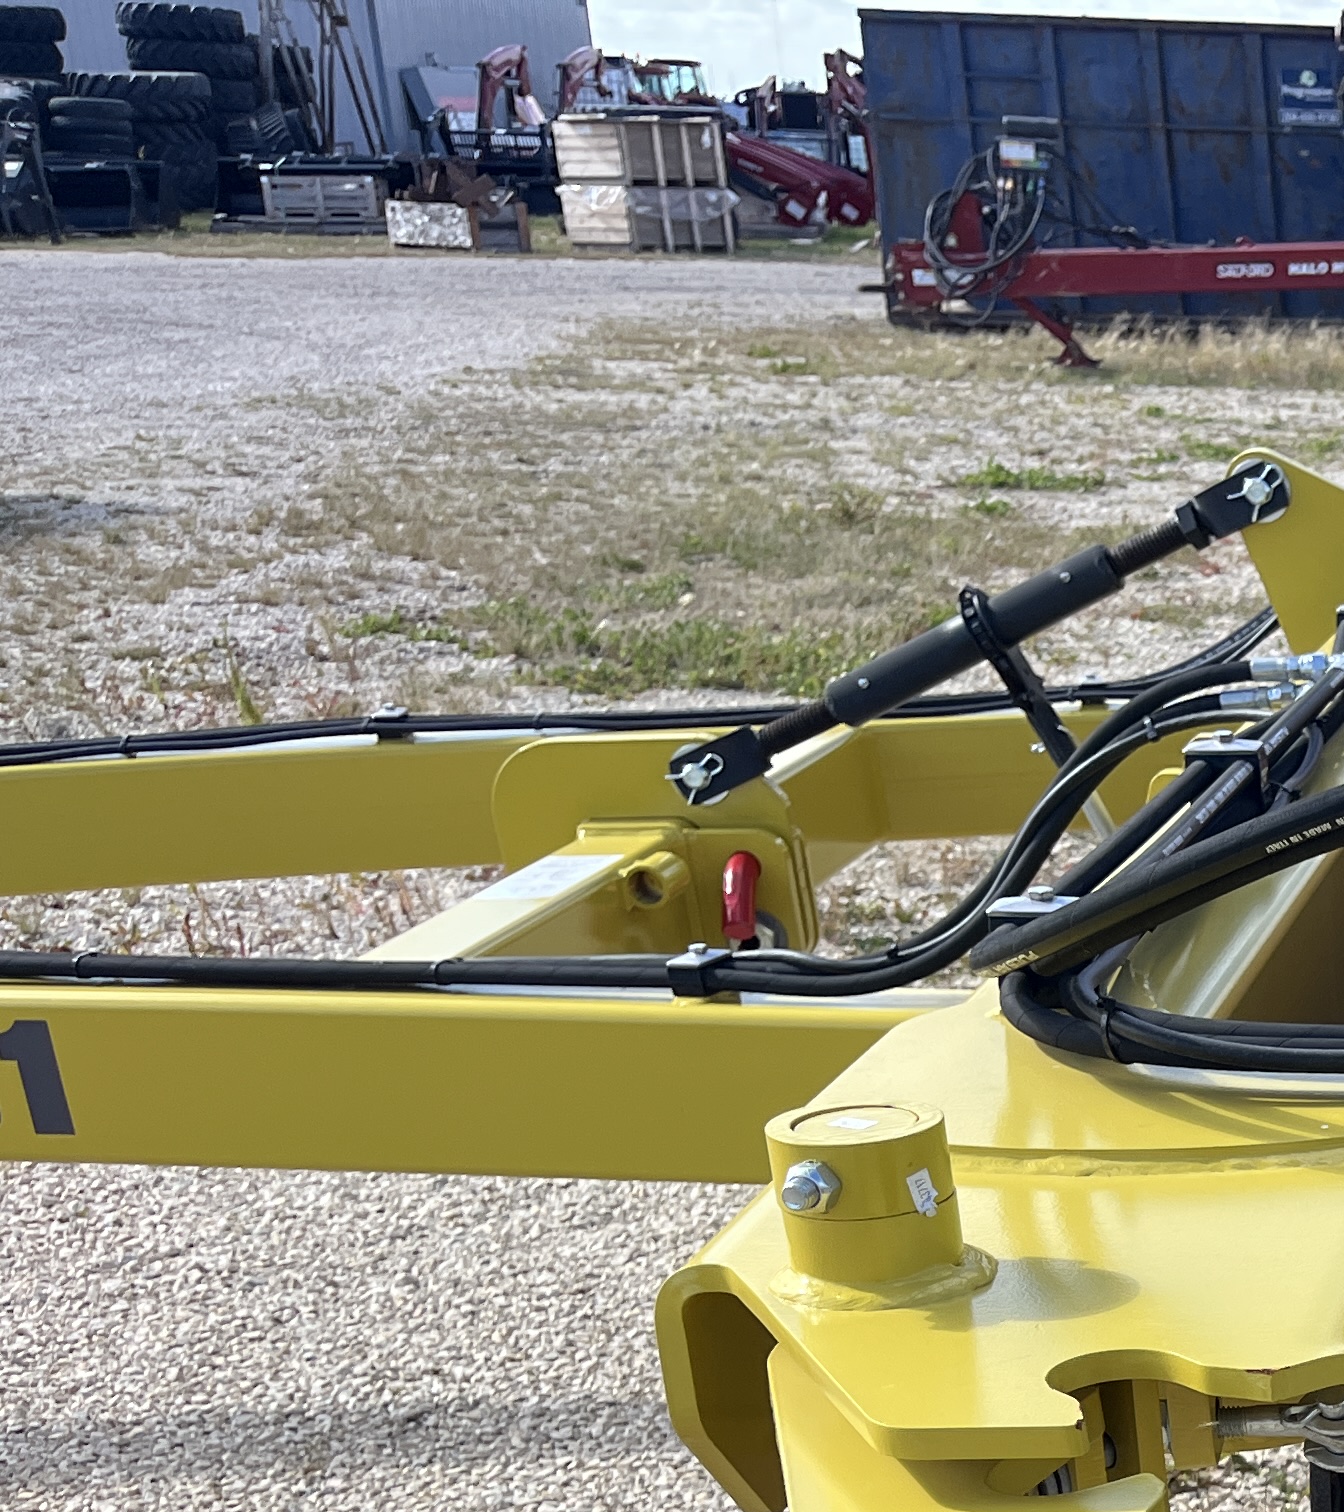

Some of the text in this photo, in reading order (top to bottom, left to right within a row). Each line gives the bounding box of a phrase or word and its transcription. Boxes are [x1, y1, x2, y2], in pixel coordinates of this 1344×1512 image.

[1289, 833, 1303, 843] IN
[1304, 822, 1332, 839] MADE
[1265, 838, 1290, 854] ITALY
[0, 1020, 75, 1134] 1
